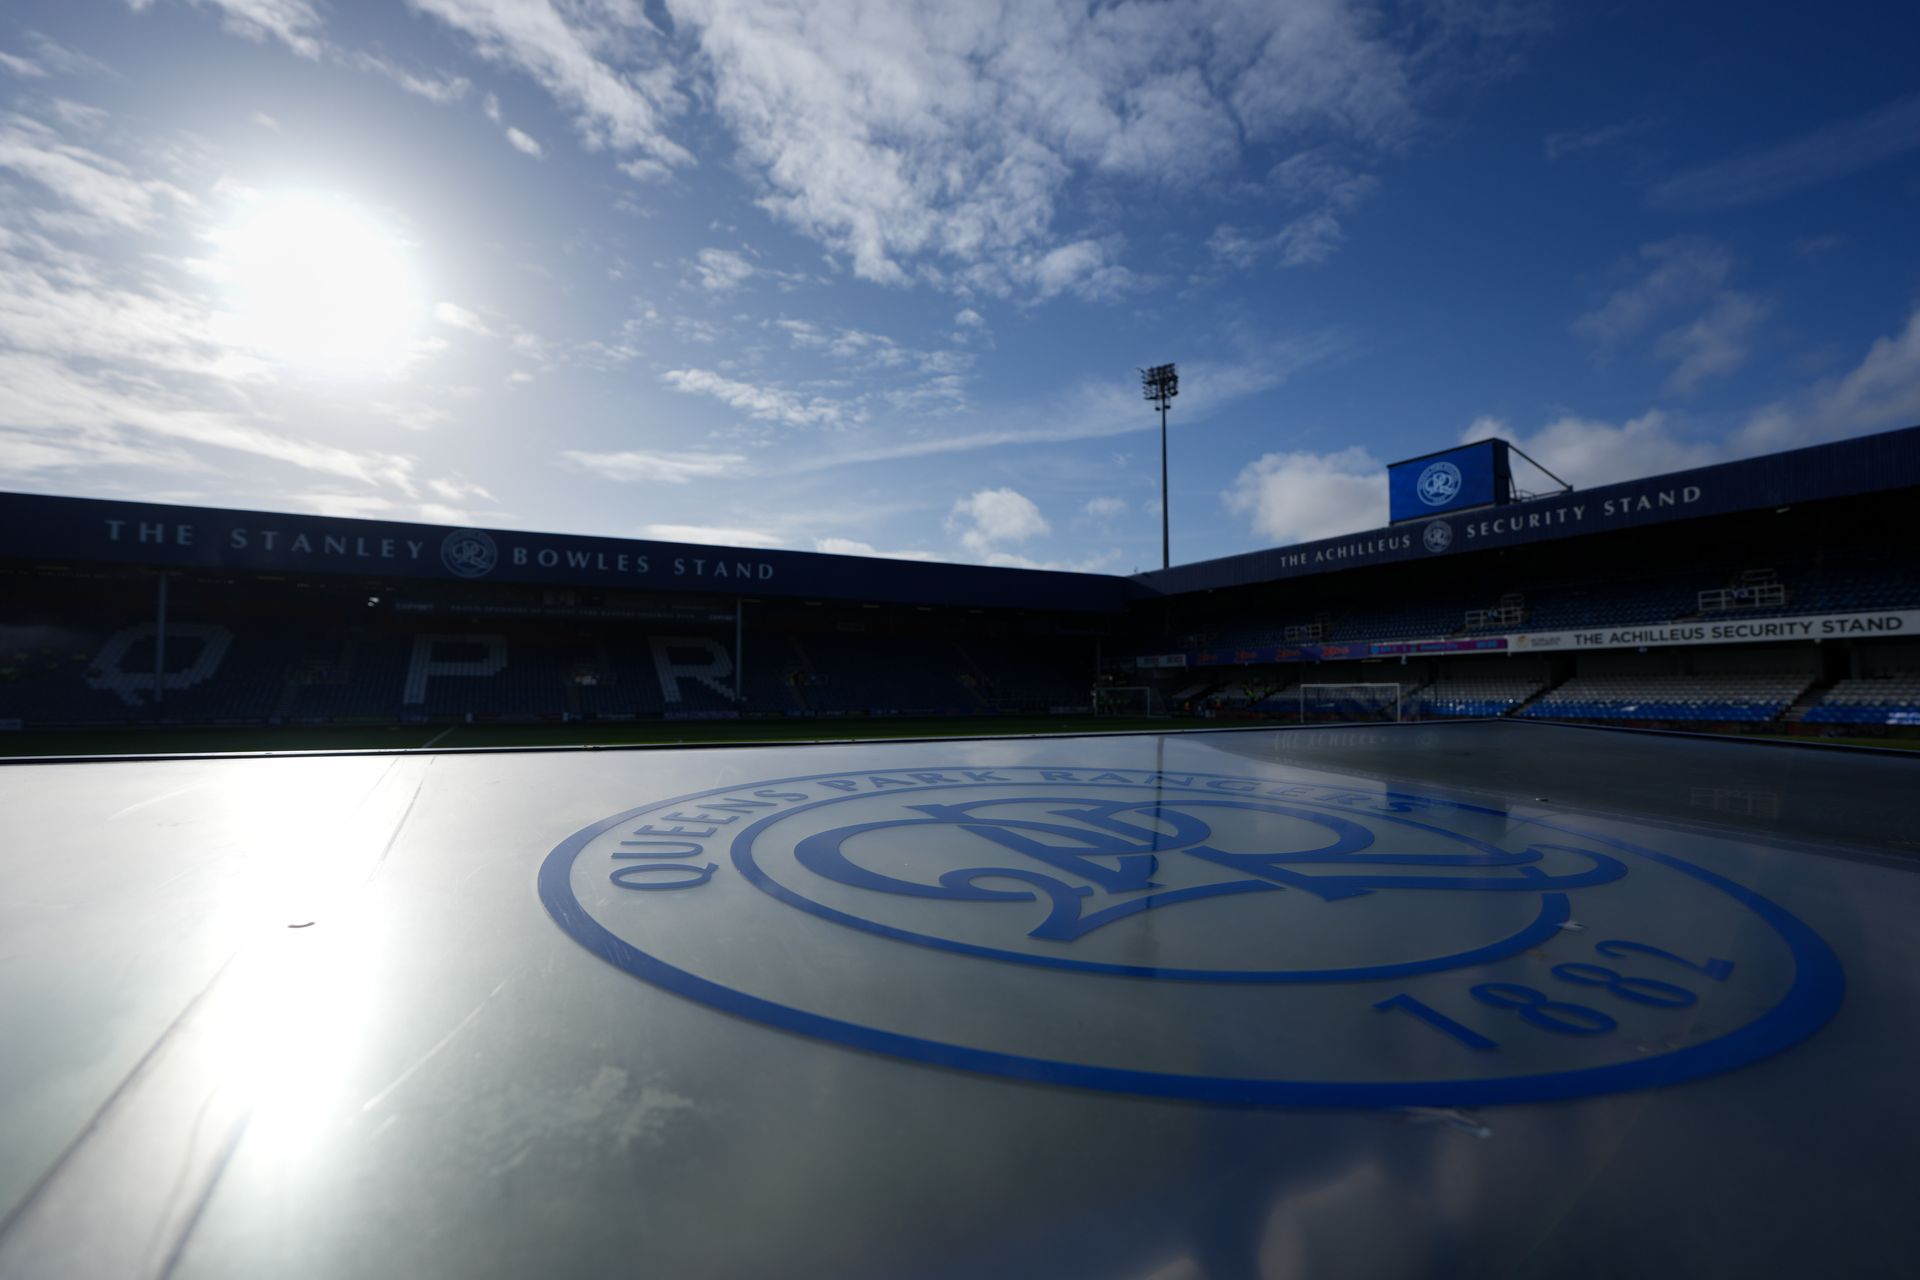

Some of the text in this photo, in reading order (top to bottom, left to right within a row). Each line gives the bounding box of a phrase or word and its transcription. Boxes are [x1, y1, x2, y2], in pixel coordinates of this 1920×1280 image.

[104, 519, 194, 546] THE
[230, 528, 424, 560] STANLEY
[513, 546, 649, 574] BOWLES
[673, 557, 774, 581] STAND
[1280, 552, 1307, 568] THE
[1315, 534, 1411, 563] ACHILLEUS
[1466, 504, 1585, 539] SECURITY
[1603, 485, 1701, 517] STAND
[1574, 632, 1603, 646] THE
[1609, 627, 1704, 644] ACHILLEUS
[1712, 621, 1813, 639] SECURITY
[1822, 616, 1903, 634] STAND
[609, 770, 1432, 892] QUEENS PARK RANGERS
[1371, 939, 1735, 1050] 1882
